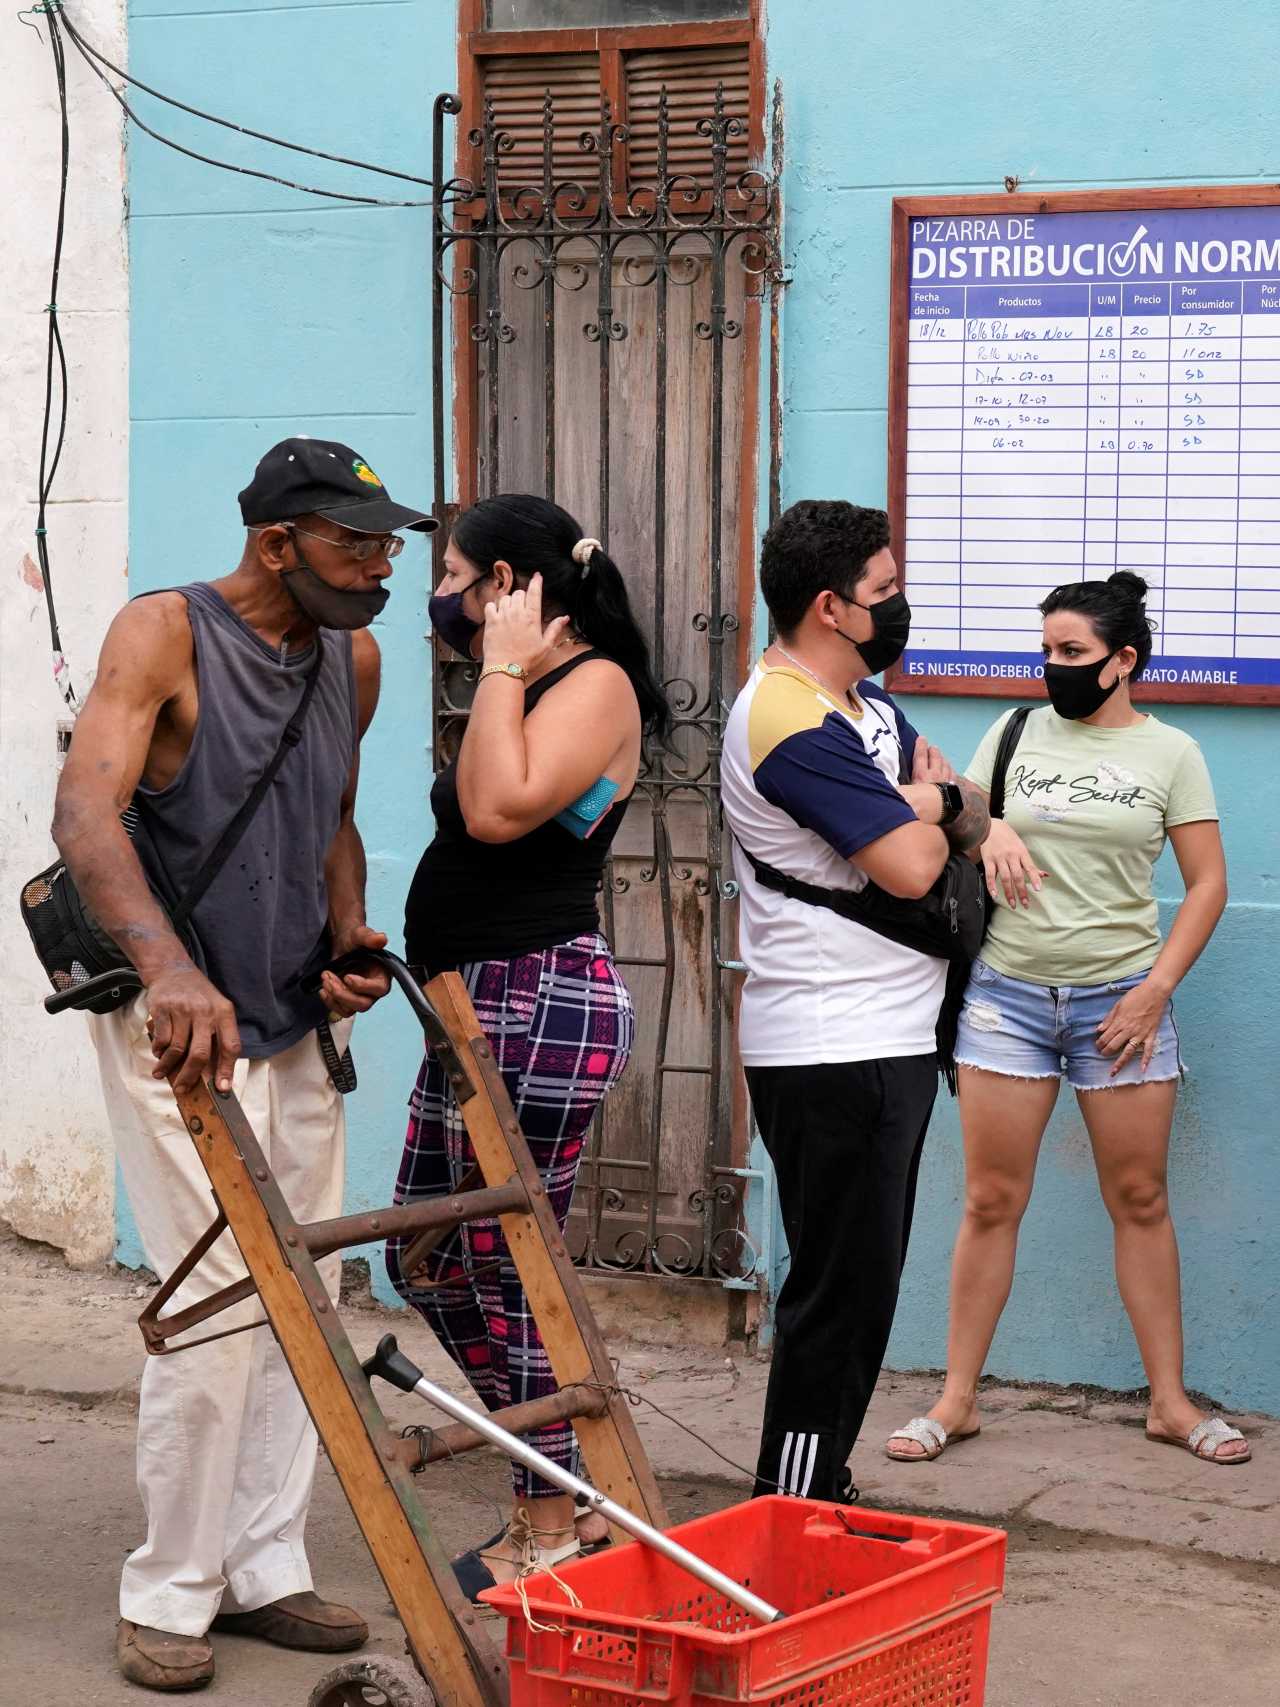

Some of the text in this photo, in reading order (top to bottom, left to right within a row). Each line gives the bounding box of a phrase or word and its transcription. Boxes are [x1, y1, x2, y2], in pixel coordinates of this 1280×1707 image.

[912, 219, 1035, 242] PIZARRA DE
[1181, 286, 1197, 296] Por
[1261, 284, 1277, 295] Por
[914, 292, 940, 303] Fecha
[998, 296, 1042, 307] Productos
[1097, 294, 1116, 305] U/M
[1133, 294, 1161, 305] Precio
[914, 304, 950, 316] de inicio
[1181, 299, 1234, 311] consumidor
[1130, 326, 1149, 336] 20
[908, 661, 925, 676] ES
[927, 661, 988, 678] NUESTRO
[990, 663, 1032, 679] DEBER
[1181, 669, 1238, 685] AMABLE
[1011, 765, 1146, 808] Kept Secret
